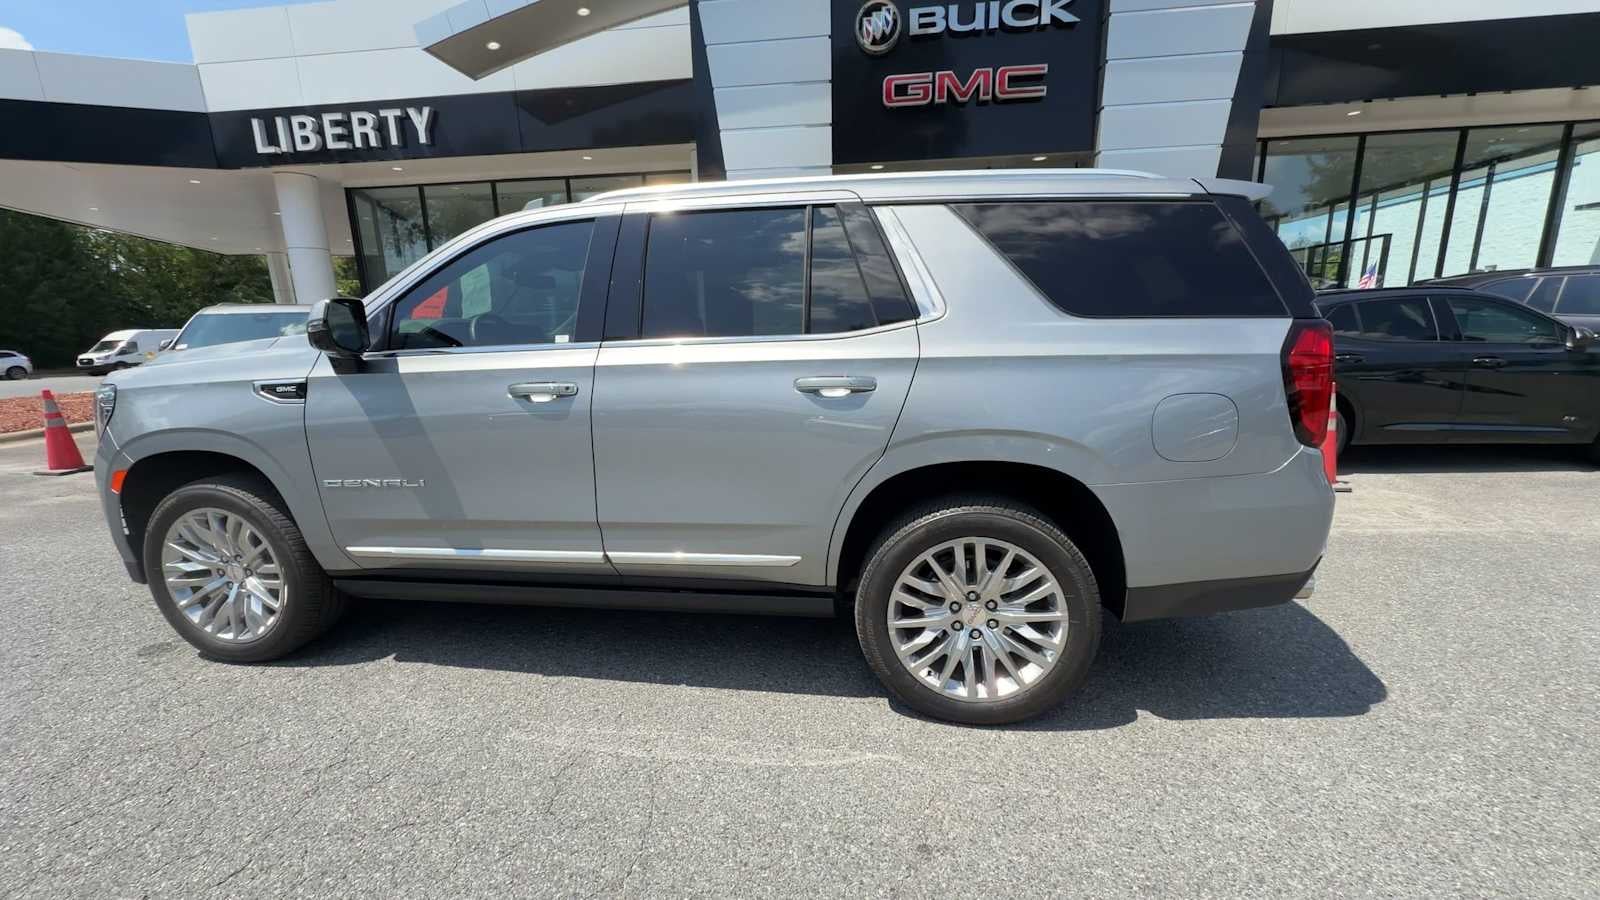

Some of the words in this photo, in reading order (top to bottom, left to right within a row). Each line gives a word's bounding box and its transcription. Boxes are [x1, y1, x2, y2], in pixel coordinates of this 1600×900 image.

[909, 0, 1080, 36] BUICK
[883, 64, 1048, 106] GMC
[251, 106, 432, 154] LIBERTY
[276, 385, 297, 393] GMC
[321, 479, 425, 488] DENALI
